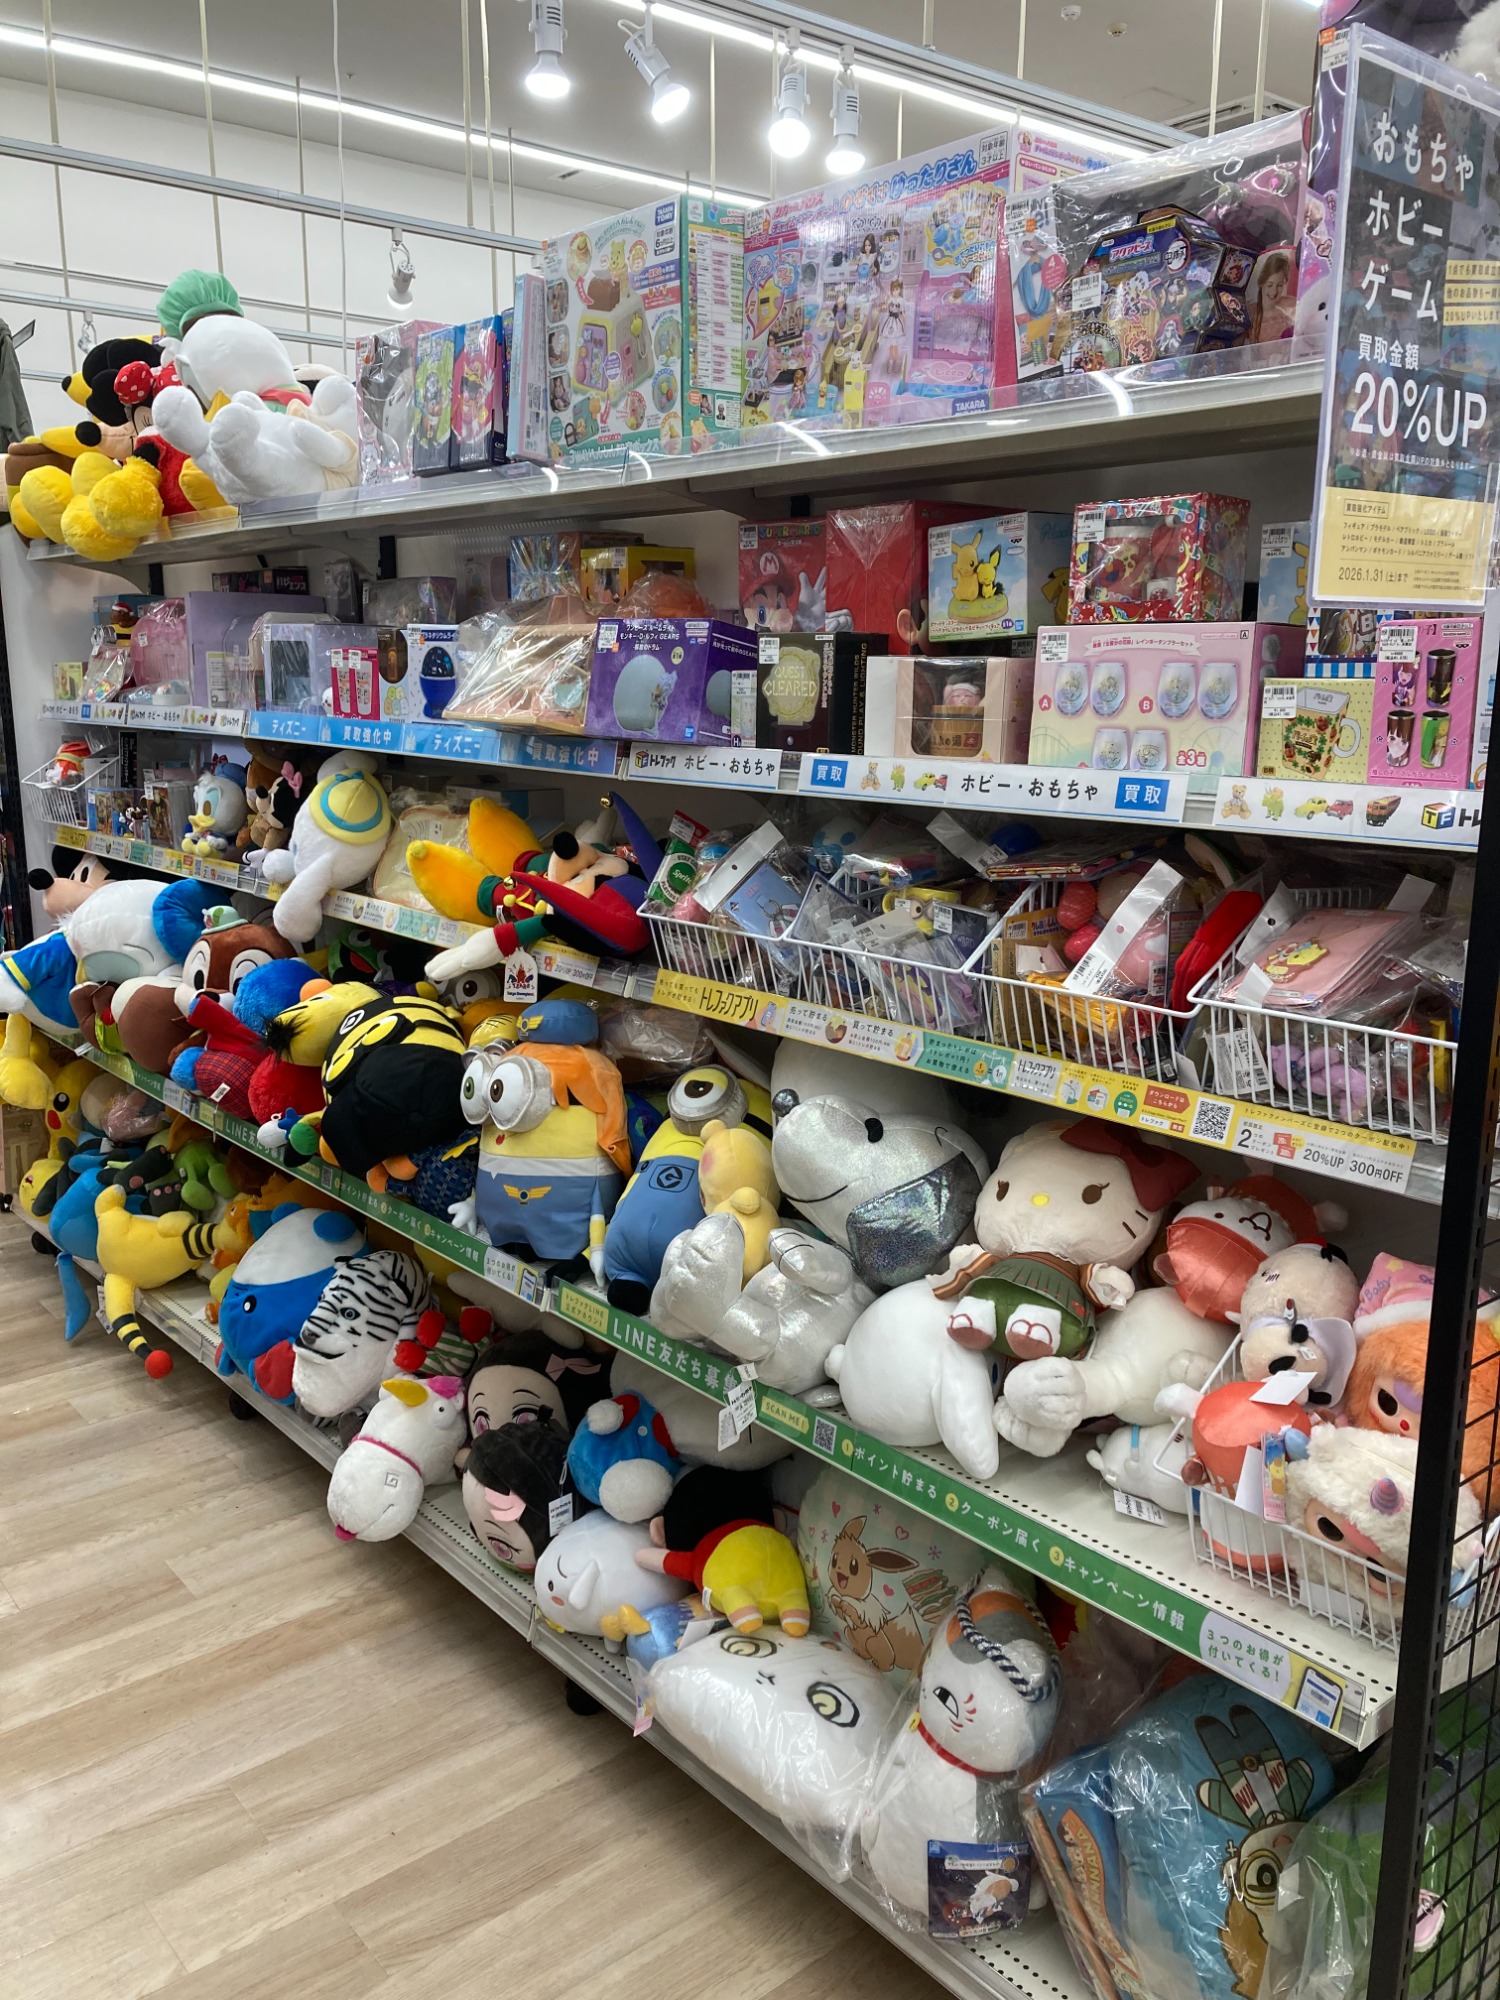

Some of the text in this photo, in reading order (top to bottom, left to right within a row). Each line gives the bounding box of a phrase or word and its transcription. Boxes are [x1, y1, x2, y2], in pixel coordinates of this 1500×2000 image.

[1373, 112, 1474, 192] おもちゃ
[1366, 190, 1444, 246] ホビー
[1111, 241, 1152, 261] アクアビーズ
[1361, 259, 1438, 323] ゲーム
[1358, 333, 1420, 371] 買取金額
[955, 399, 985, 413] TAKARA
[1350, 372, 1487, 448] 20%UP
[1346, 503, 1386, 515] 買取強化アイテム
[1343, 522, 1365, 530] フィギュア
[1342, 533, 1368, 542] レトロホビー
[1341, 545, 1368, 553] アンパンマン
[626, 624, 649, 632] ワンピース
[774, 666, 805, 679] QUEST
[763, 681, 817, 697] CLEARED
[272, 720, 307, 736] ディズニー
[343, 725, 392, 745] 買取強化中
[434, 734, 481, 754] ディズニー
[532, 742, 599, 767] 買取強化中
[1176, 749, 1206, 766] 全3種
[650, 754, 676, 768] トレファク
[684, 754, 775, 776] ホビー・おもちゃ
[817, 765, 843, 782] 買取
[961, 774, 1098, 801] ホビー・おもちゃ
[1124, 784, 1161, 804] 買取
[699, 986, 760, 1022] トレファクアプリ
[790, 1006, 828, 1022] 売って貯まる
[852, 1020, 894, 1037] 買って貯まる
[1149, 1090, 1185, 1103] ダウンロードは
[1152, 1098, 1178, 1109] こちらから
[1141, 1116, 1164, 1126] トレファク
[1237, 1128, 1253, 1149] 2
[1251, 1145, 1275, 1155] プレゼント
[1303, 1148, 1345, 1169] 20%UP
[1349, 1160, 1404, 1183] 300円OFF
[1365, 1276, 1392, 1300] Baby
[566, 1293, 604, 1318] トレファクLINE
[765, 1401, 787, 1419] SCAN
[855, 1447, 937, 1499] ポイント貯まる
[961, 1501, 1041, 1553] クーポン届く
[1064, 1556, 1186, 1632] キャンペーン情報
[1207, 1629, 1285, 1667] 3つのお得が
[1208, 1645, 1280, 1683] 付いてくる!
